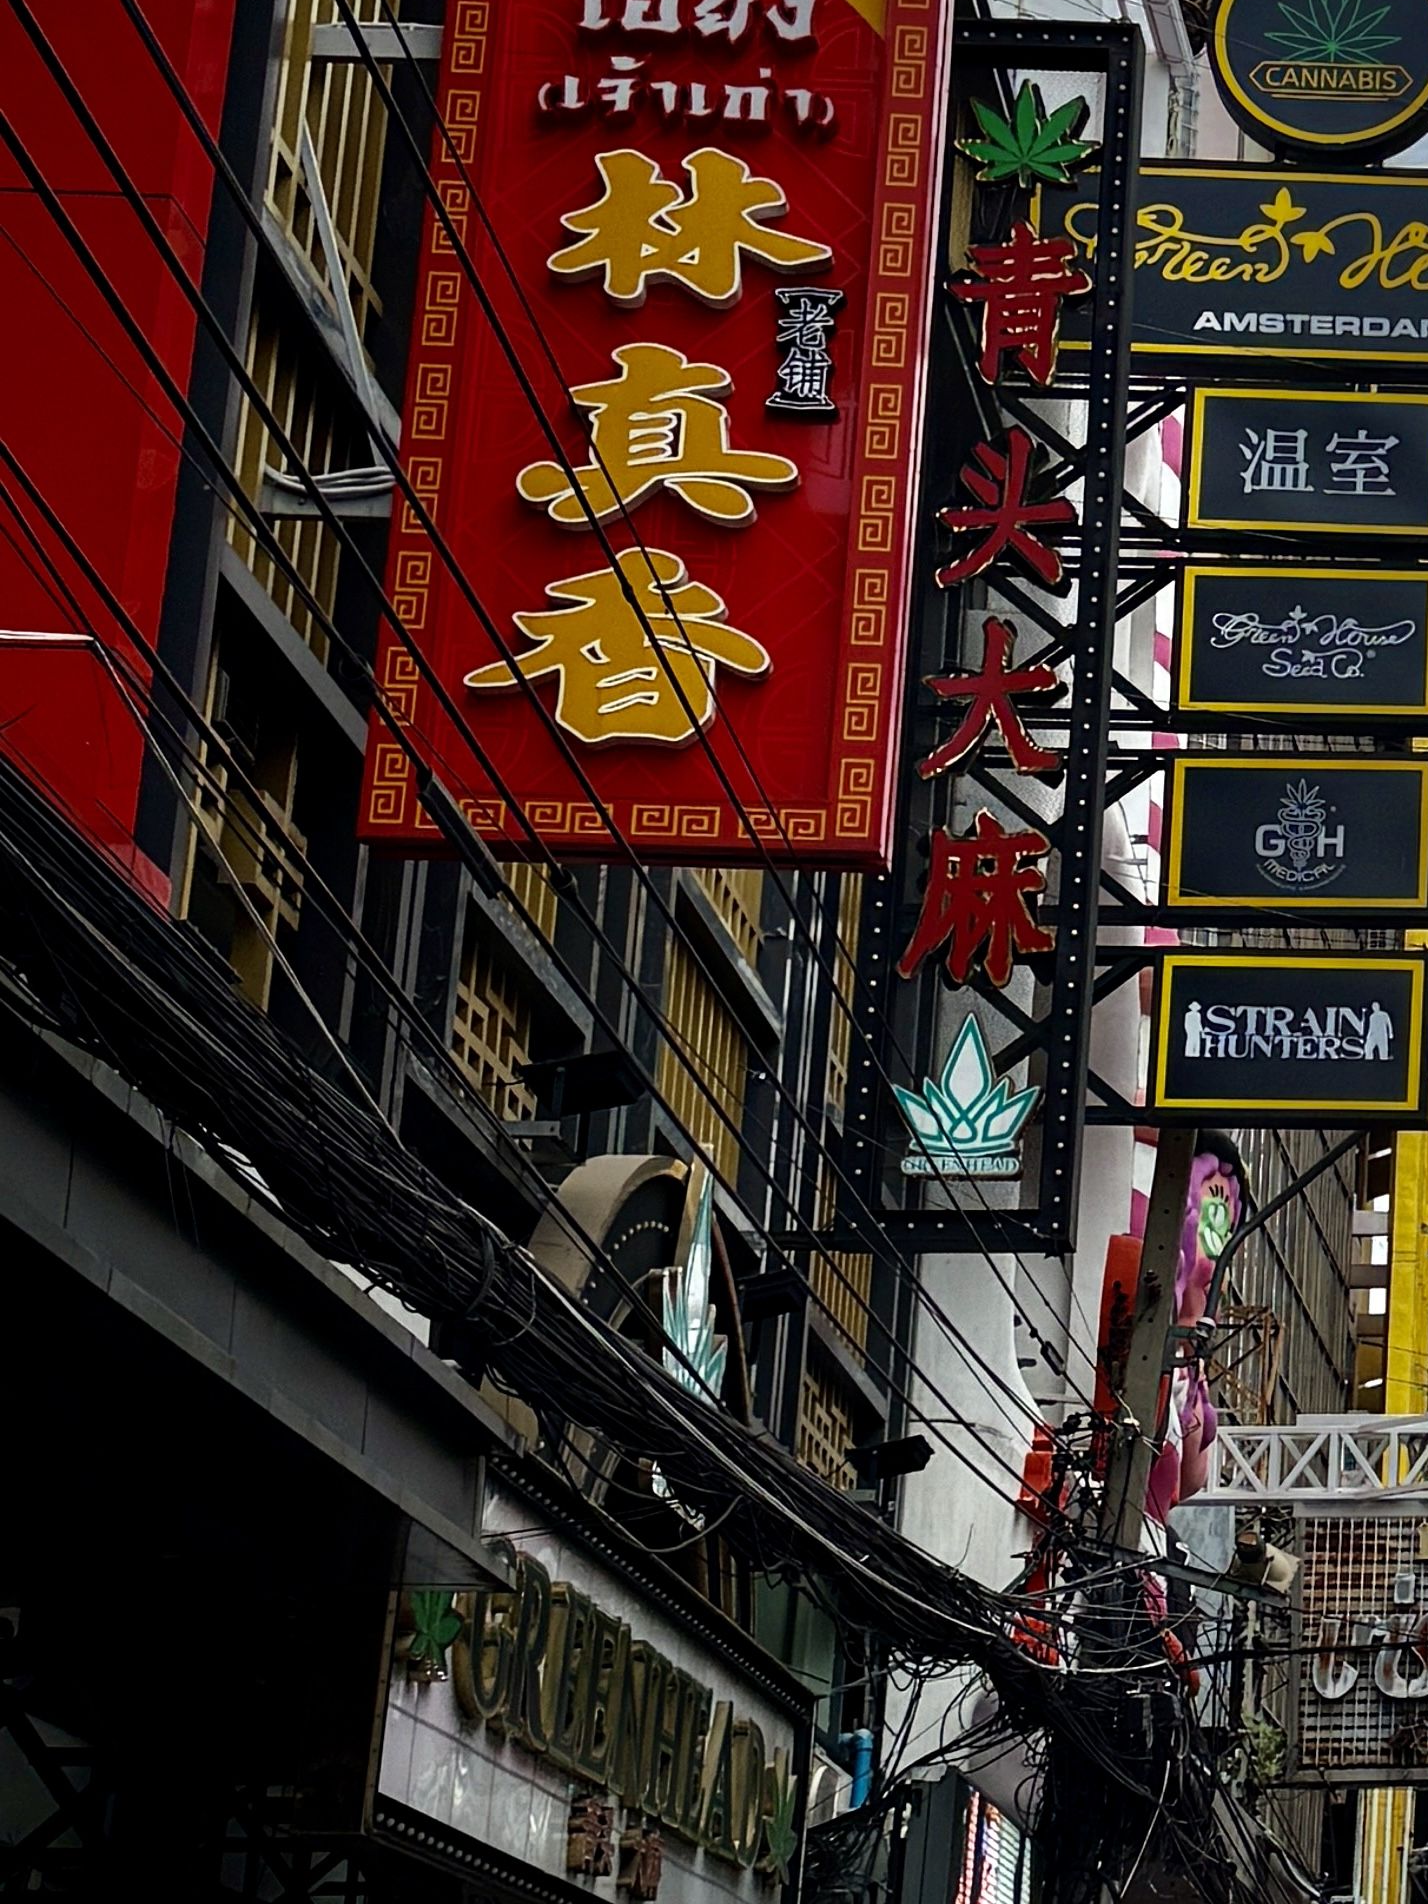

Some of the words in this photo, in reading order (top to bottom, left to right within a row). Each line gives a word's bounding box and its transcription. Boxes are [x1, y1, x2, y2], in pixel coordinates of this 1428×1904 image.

[1265, 65, 1401, 92] CANNABIS
[1238, 426, 1402, 497] 温室
[1203, 1002, 1368, 1037] STRAIN
[1202, 1032, 1365, 1061] HUNTERS
